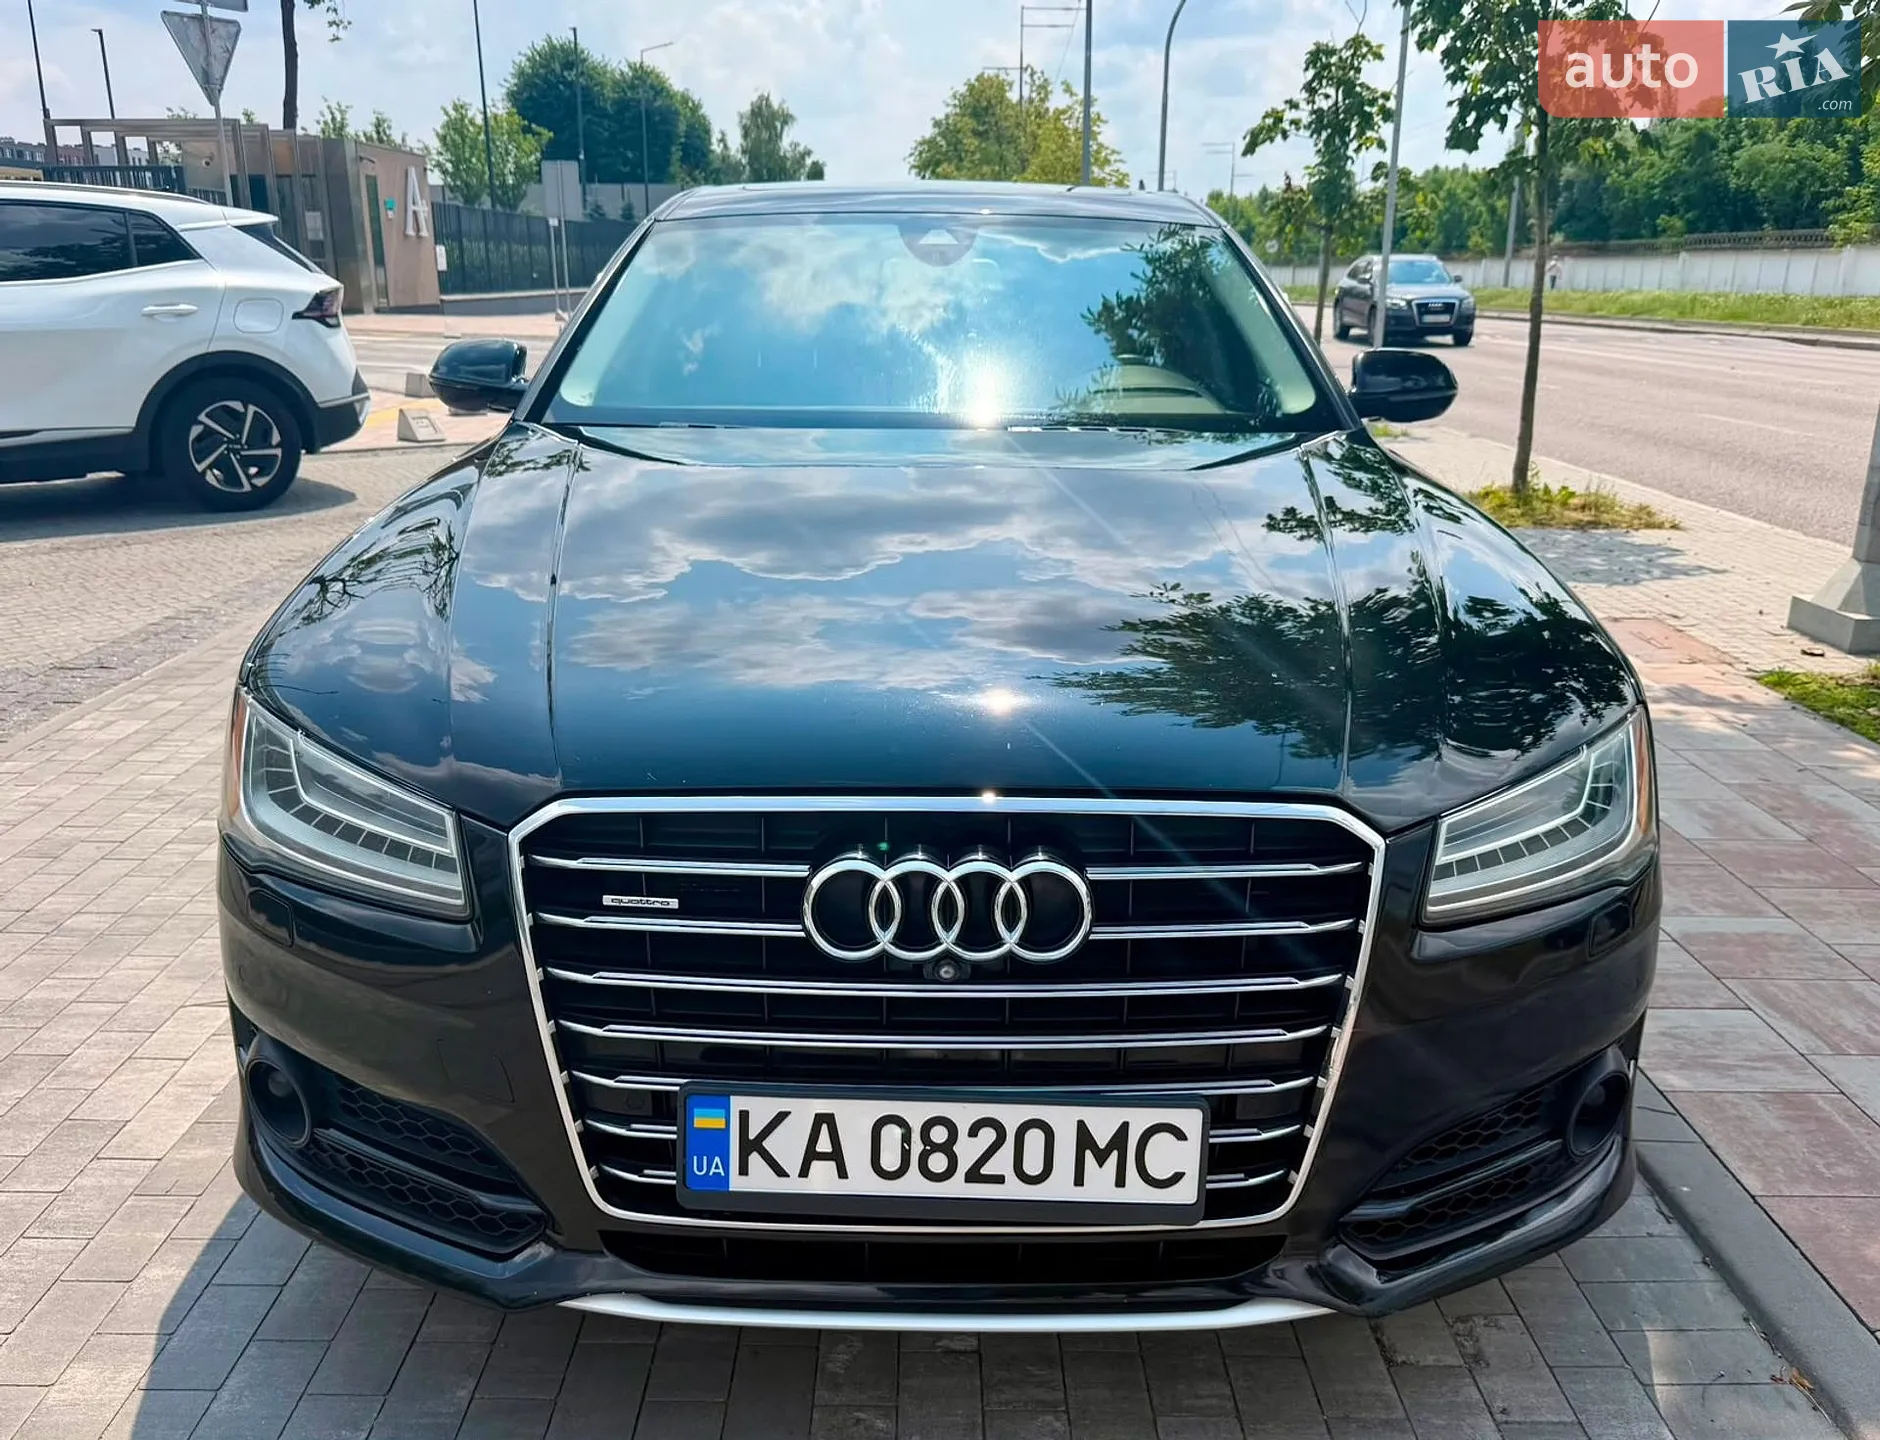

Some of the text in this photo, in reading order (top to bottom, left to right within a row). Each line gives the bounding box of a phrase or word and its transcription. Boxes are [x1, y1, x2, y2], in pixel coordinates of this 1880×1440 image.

[611, 897, 670, 907] quattro
[738, 1109, 1188, 1189] KA 0820 MC
[693, 1155, 725, 1177] UA
